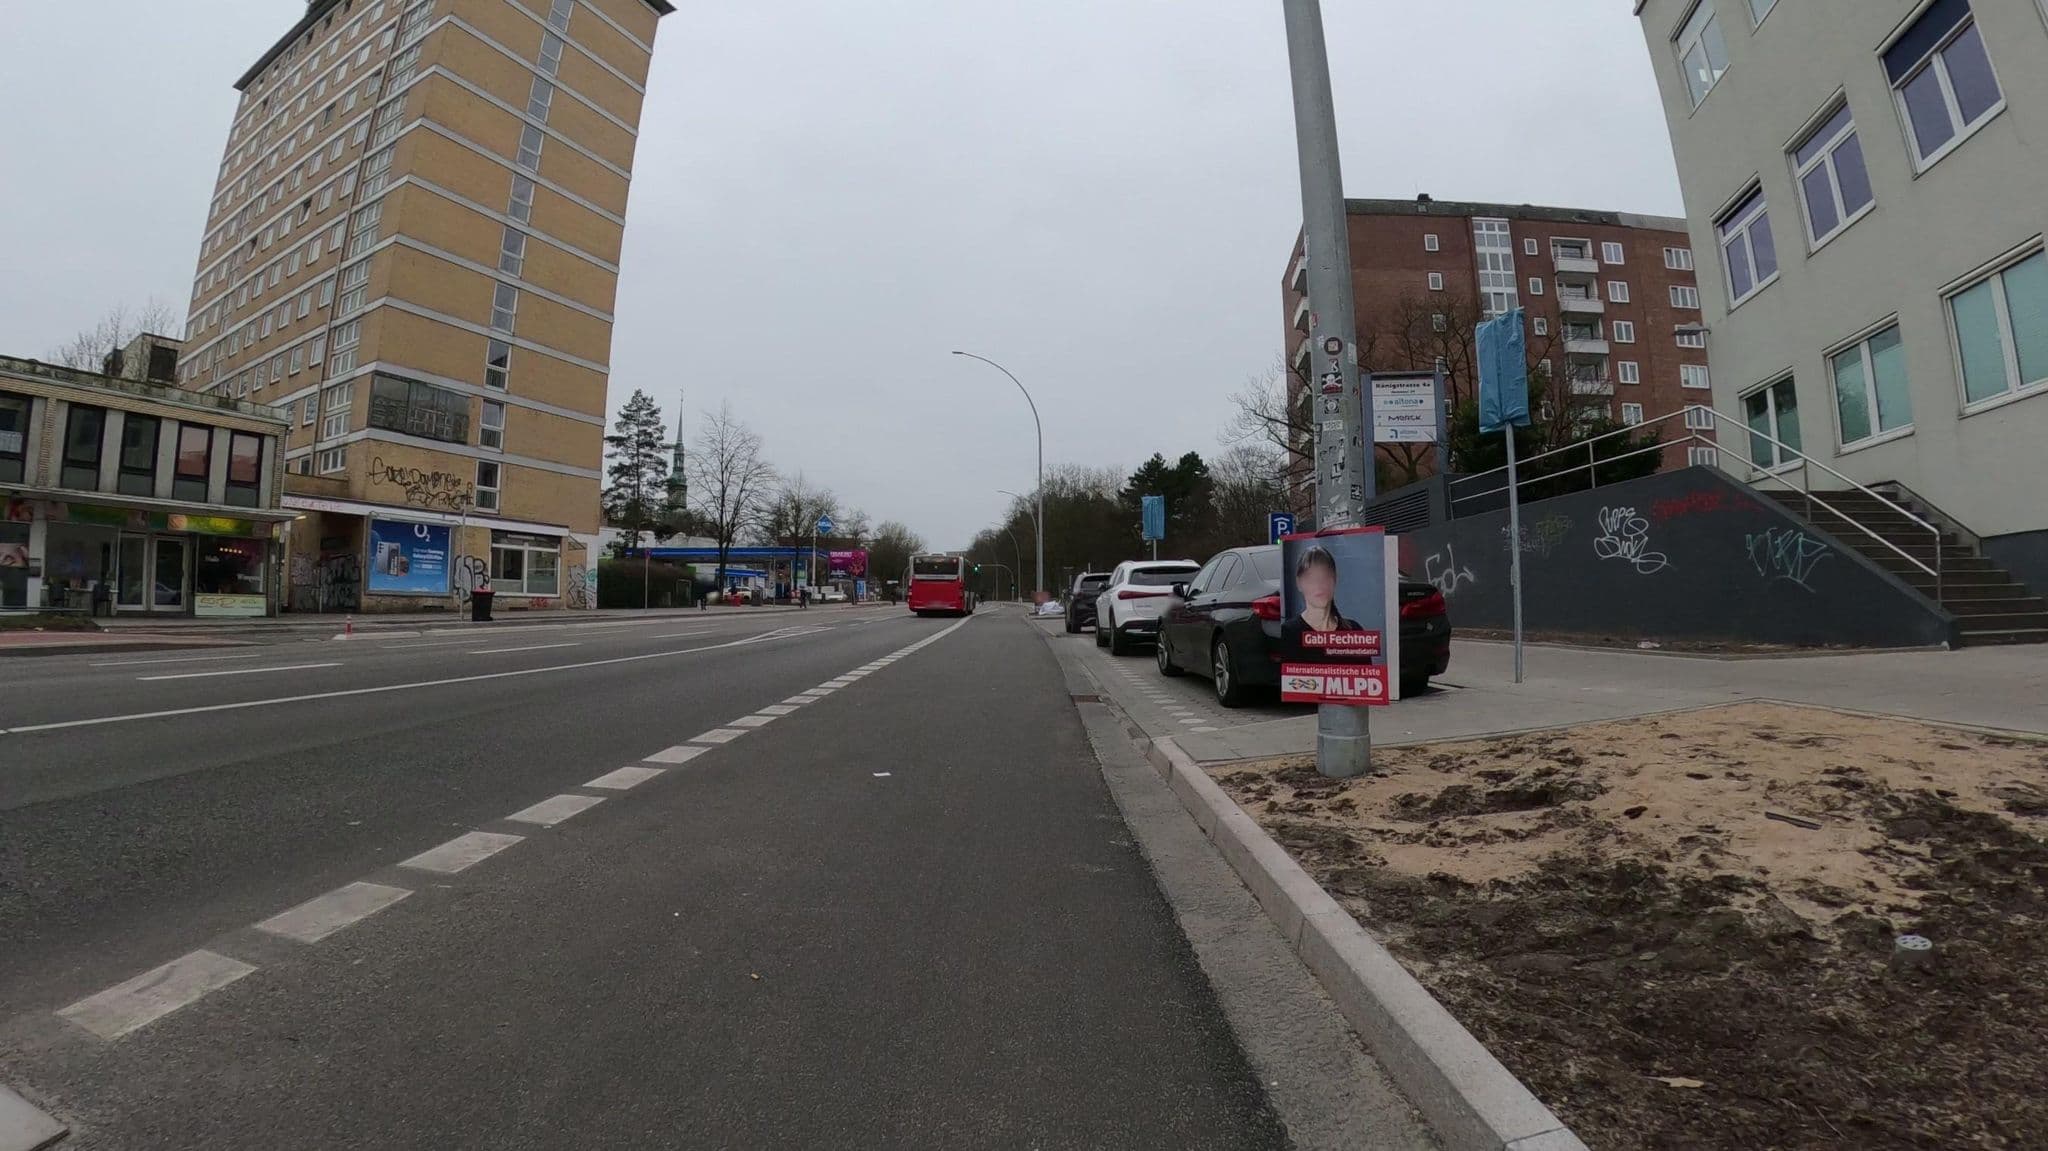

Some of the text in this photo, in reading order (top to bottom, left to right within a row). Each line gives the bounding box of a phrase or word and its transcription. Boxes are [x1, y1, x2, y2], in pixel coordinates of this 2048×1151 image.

[1278, 521, 1287, 535] P
[1304, 633, 1378, 645] Gabi Fechtner
[1286, 666, 1381, 676] Internationalistische Liste
[1325, 677, 1383, 696] MLPD
